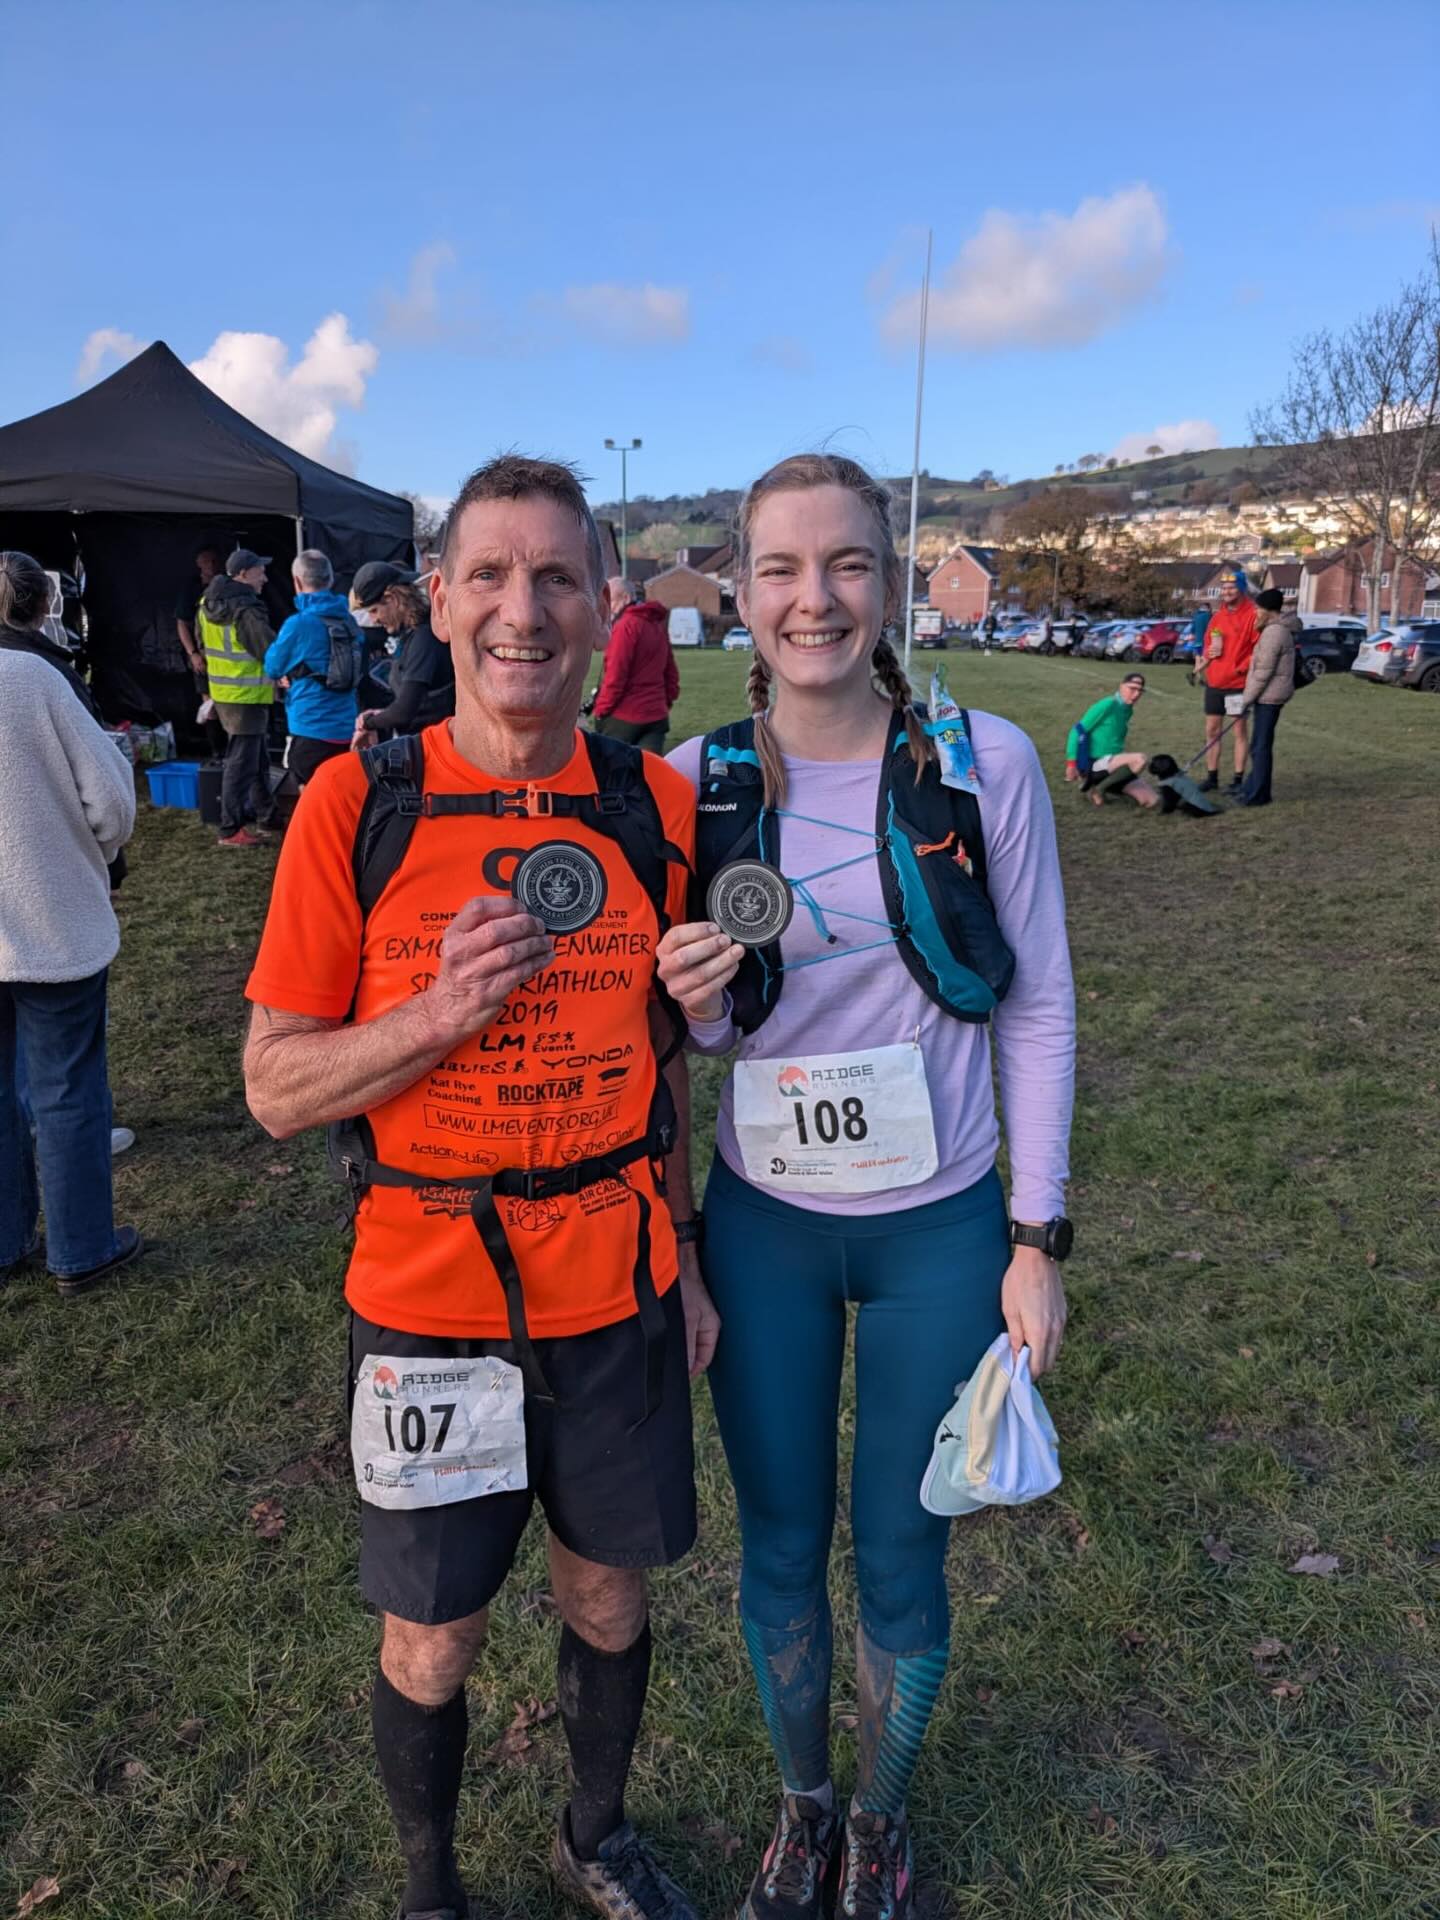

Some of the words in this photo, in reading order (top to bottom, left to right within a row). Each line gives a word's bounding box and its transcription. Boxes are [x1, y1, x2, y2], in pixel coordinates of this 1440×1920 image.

[608, 910, 627, 918] LTD
[553, 932, 651, 957] ENWATER
[519, 968, 633, 995] RIATHLON
[496, 1000, 559, 1025] 2019
[480, 1033, 525, 1052] LM
[532, 1042, 576, 1053] Events
[541, 1044, 634, 1069] YONDA
[811, 1064, 875, 1082] RIDGE
[812, 1076, 877, 1090] RUNNERS
[427, 1089, 482, 1106] Coaching
[497, 1078, 584, 1102] ROCKTAPE
[793, 1096, 869, 1145] 108
[583, 1141, 606, 1153] The
[578, 1189, 595, 1203] AIR
[402, 1371, 471, 1385] RIDGE
[384, 1402, 457, 1455] 107
